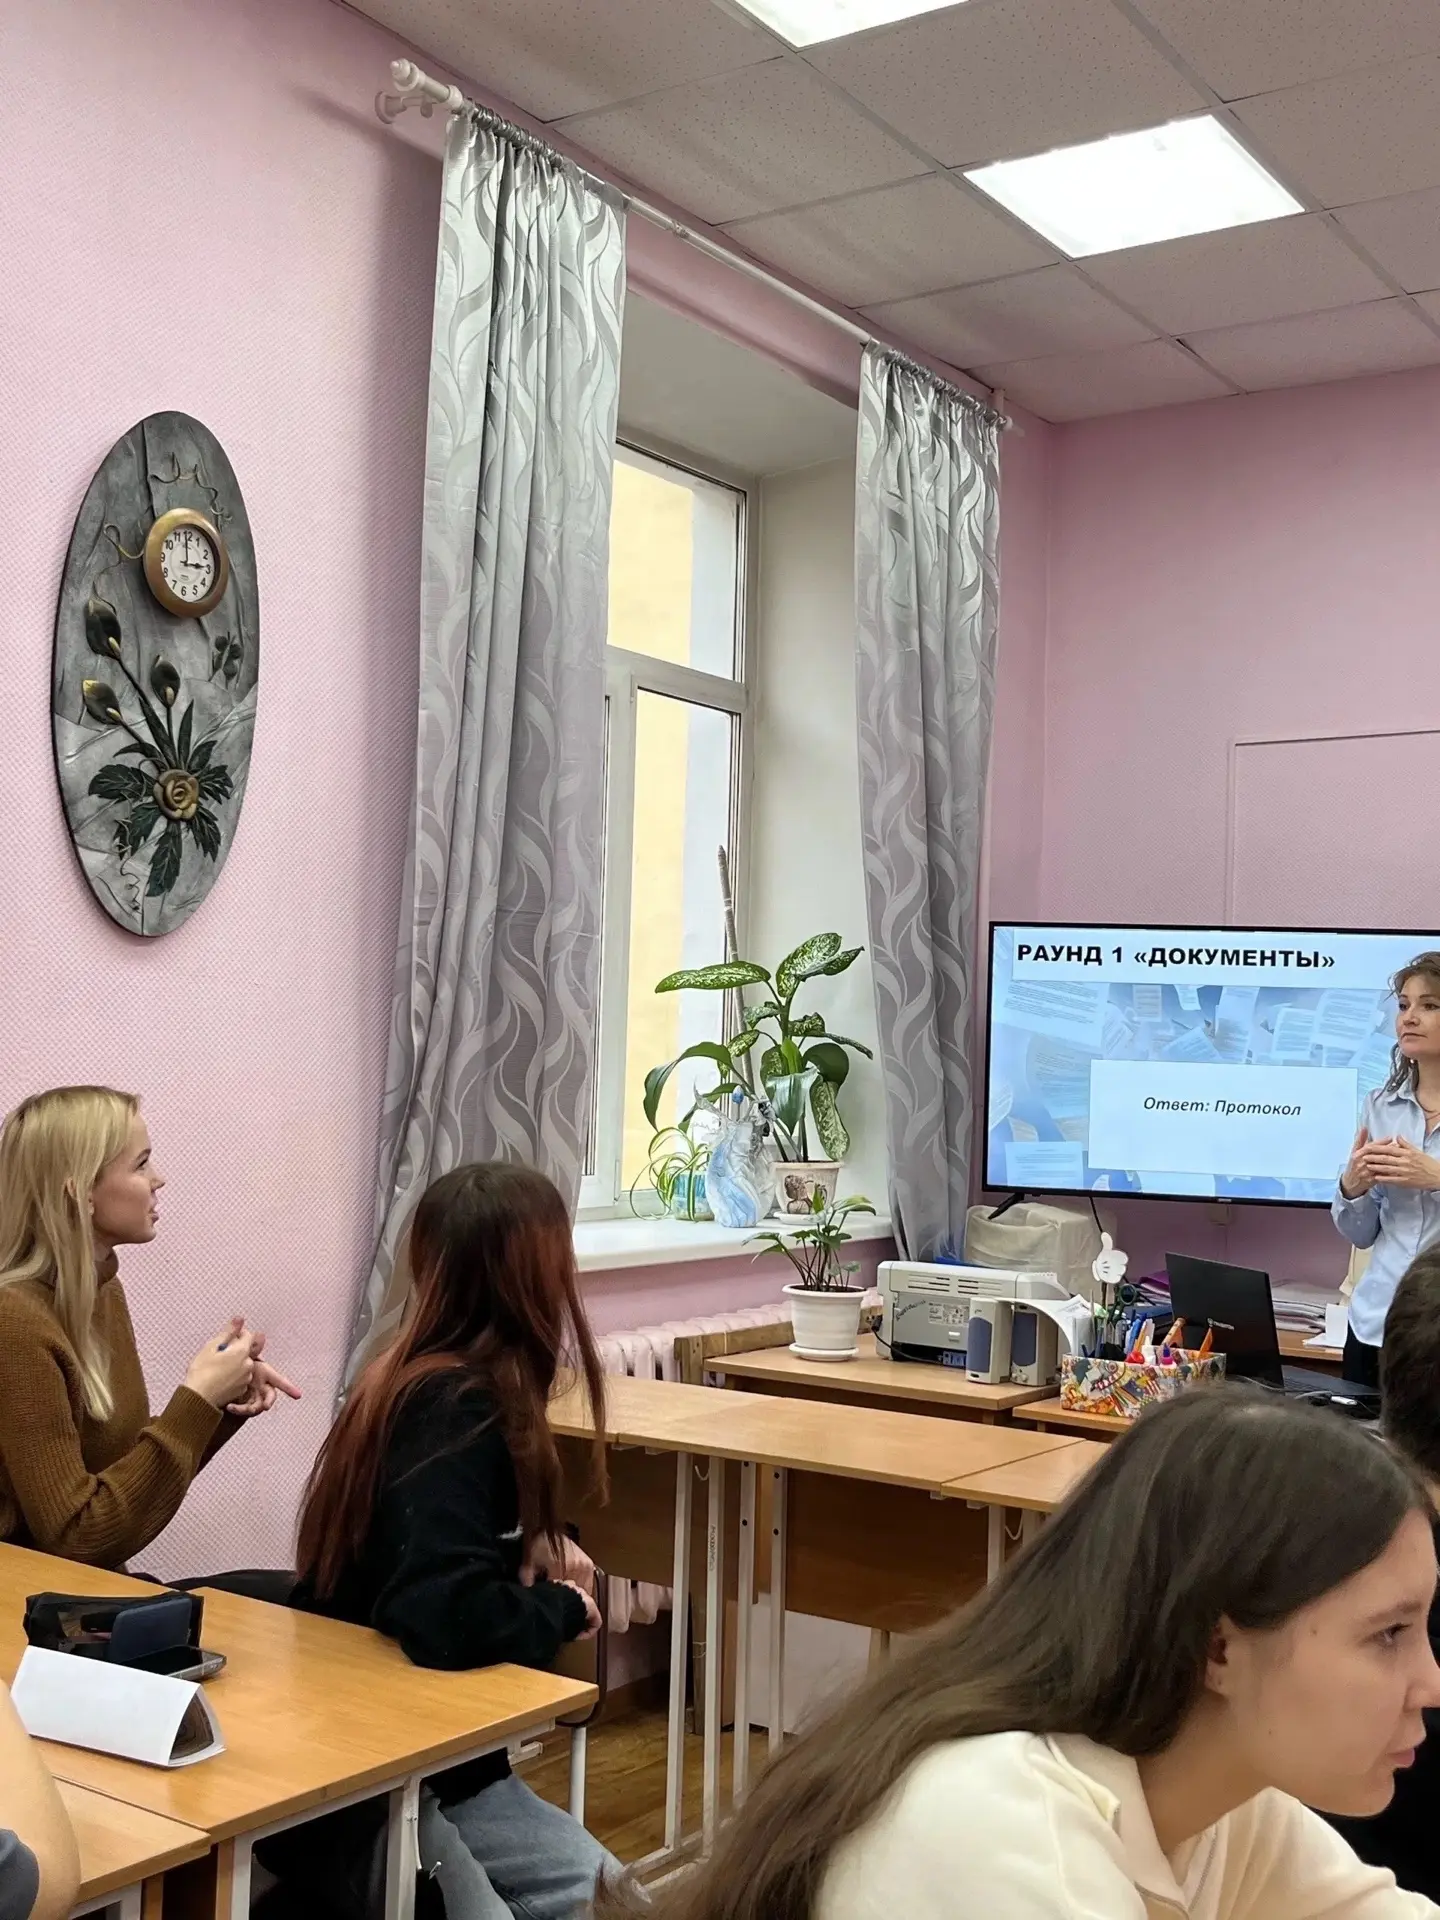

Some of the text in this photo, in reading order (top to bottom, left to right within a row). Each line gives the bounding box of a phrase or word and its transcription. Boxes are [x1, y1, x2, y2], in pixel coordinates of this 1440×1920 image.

[173, 531, 181, 542] 11
[183, 531, 193, 542] 12
[165, 539, 174, 550] 10
[195, 537, 200, 548] 1
[160, 552, 166, 562] 9
[203, 549, 209, 560] 2
[163, 567, 169, 578] 8
[205, 564, 211, 575] 3
[172, 580, 177, 590] 7
[200, 577, 206, 588] 4
[181, 586, 187, 596] 6
[192, 585, 198, 595] 5
[1017, 944, 1336, 968] РАУНД 1 «ДОКУМЕНТЫ»
[1143, 1096, 1302, 1116] Ответ: Протокол
